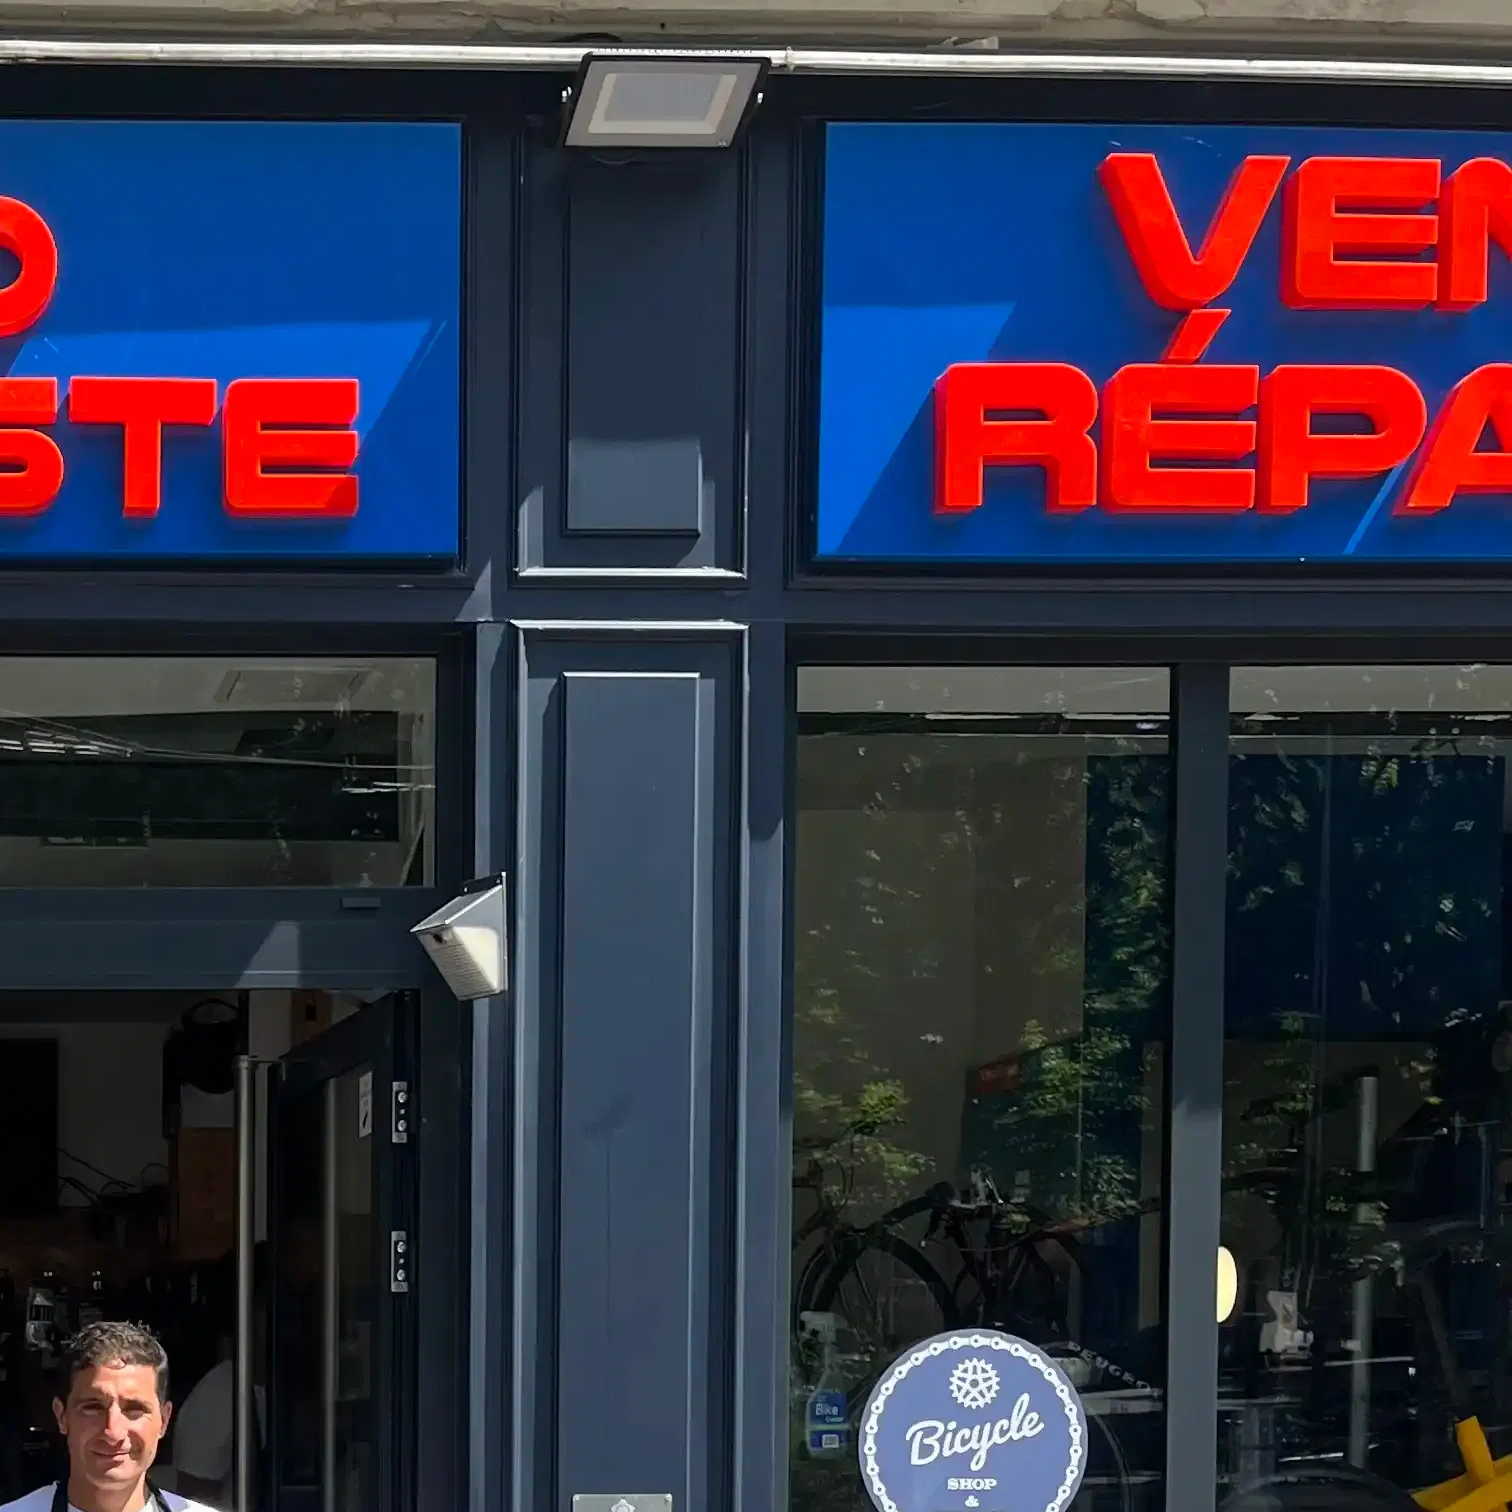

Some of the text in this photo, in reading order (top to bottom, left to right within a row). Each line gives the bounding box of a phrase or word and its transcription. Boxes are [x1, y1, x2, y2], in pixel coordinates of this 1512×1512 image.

[905, 1392, 1045, 1472] Bicycle
[947, 1478, 997, 1490] SHOP
[965, 1496, 979, 1508] &
